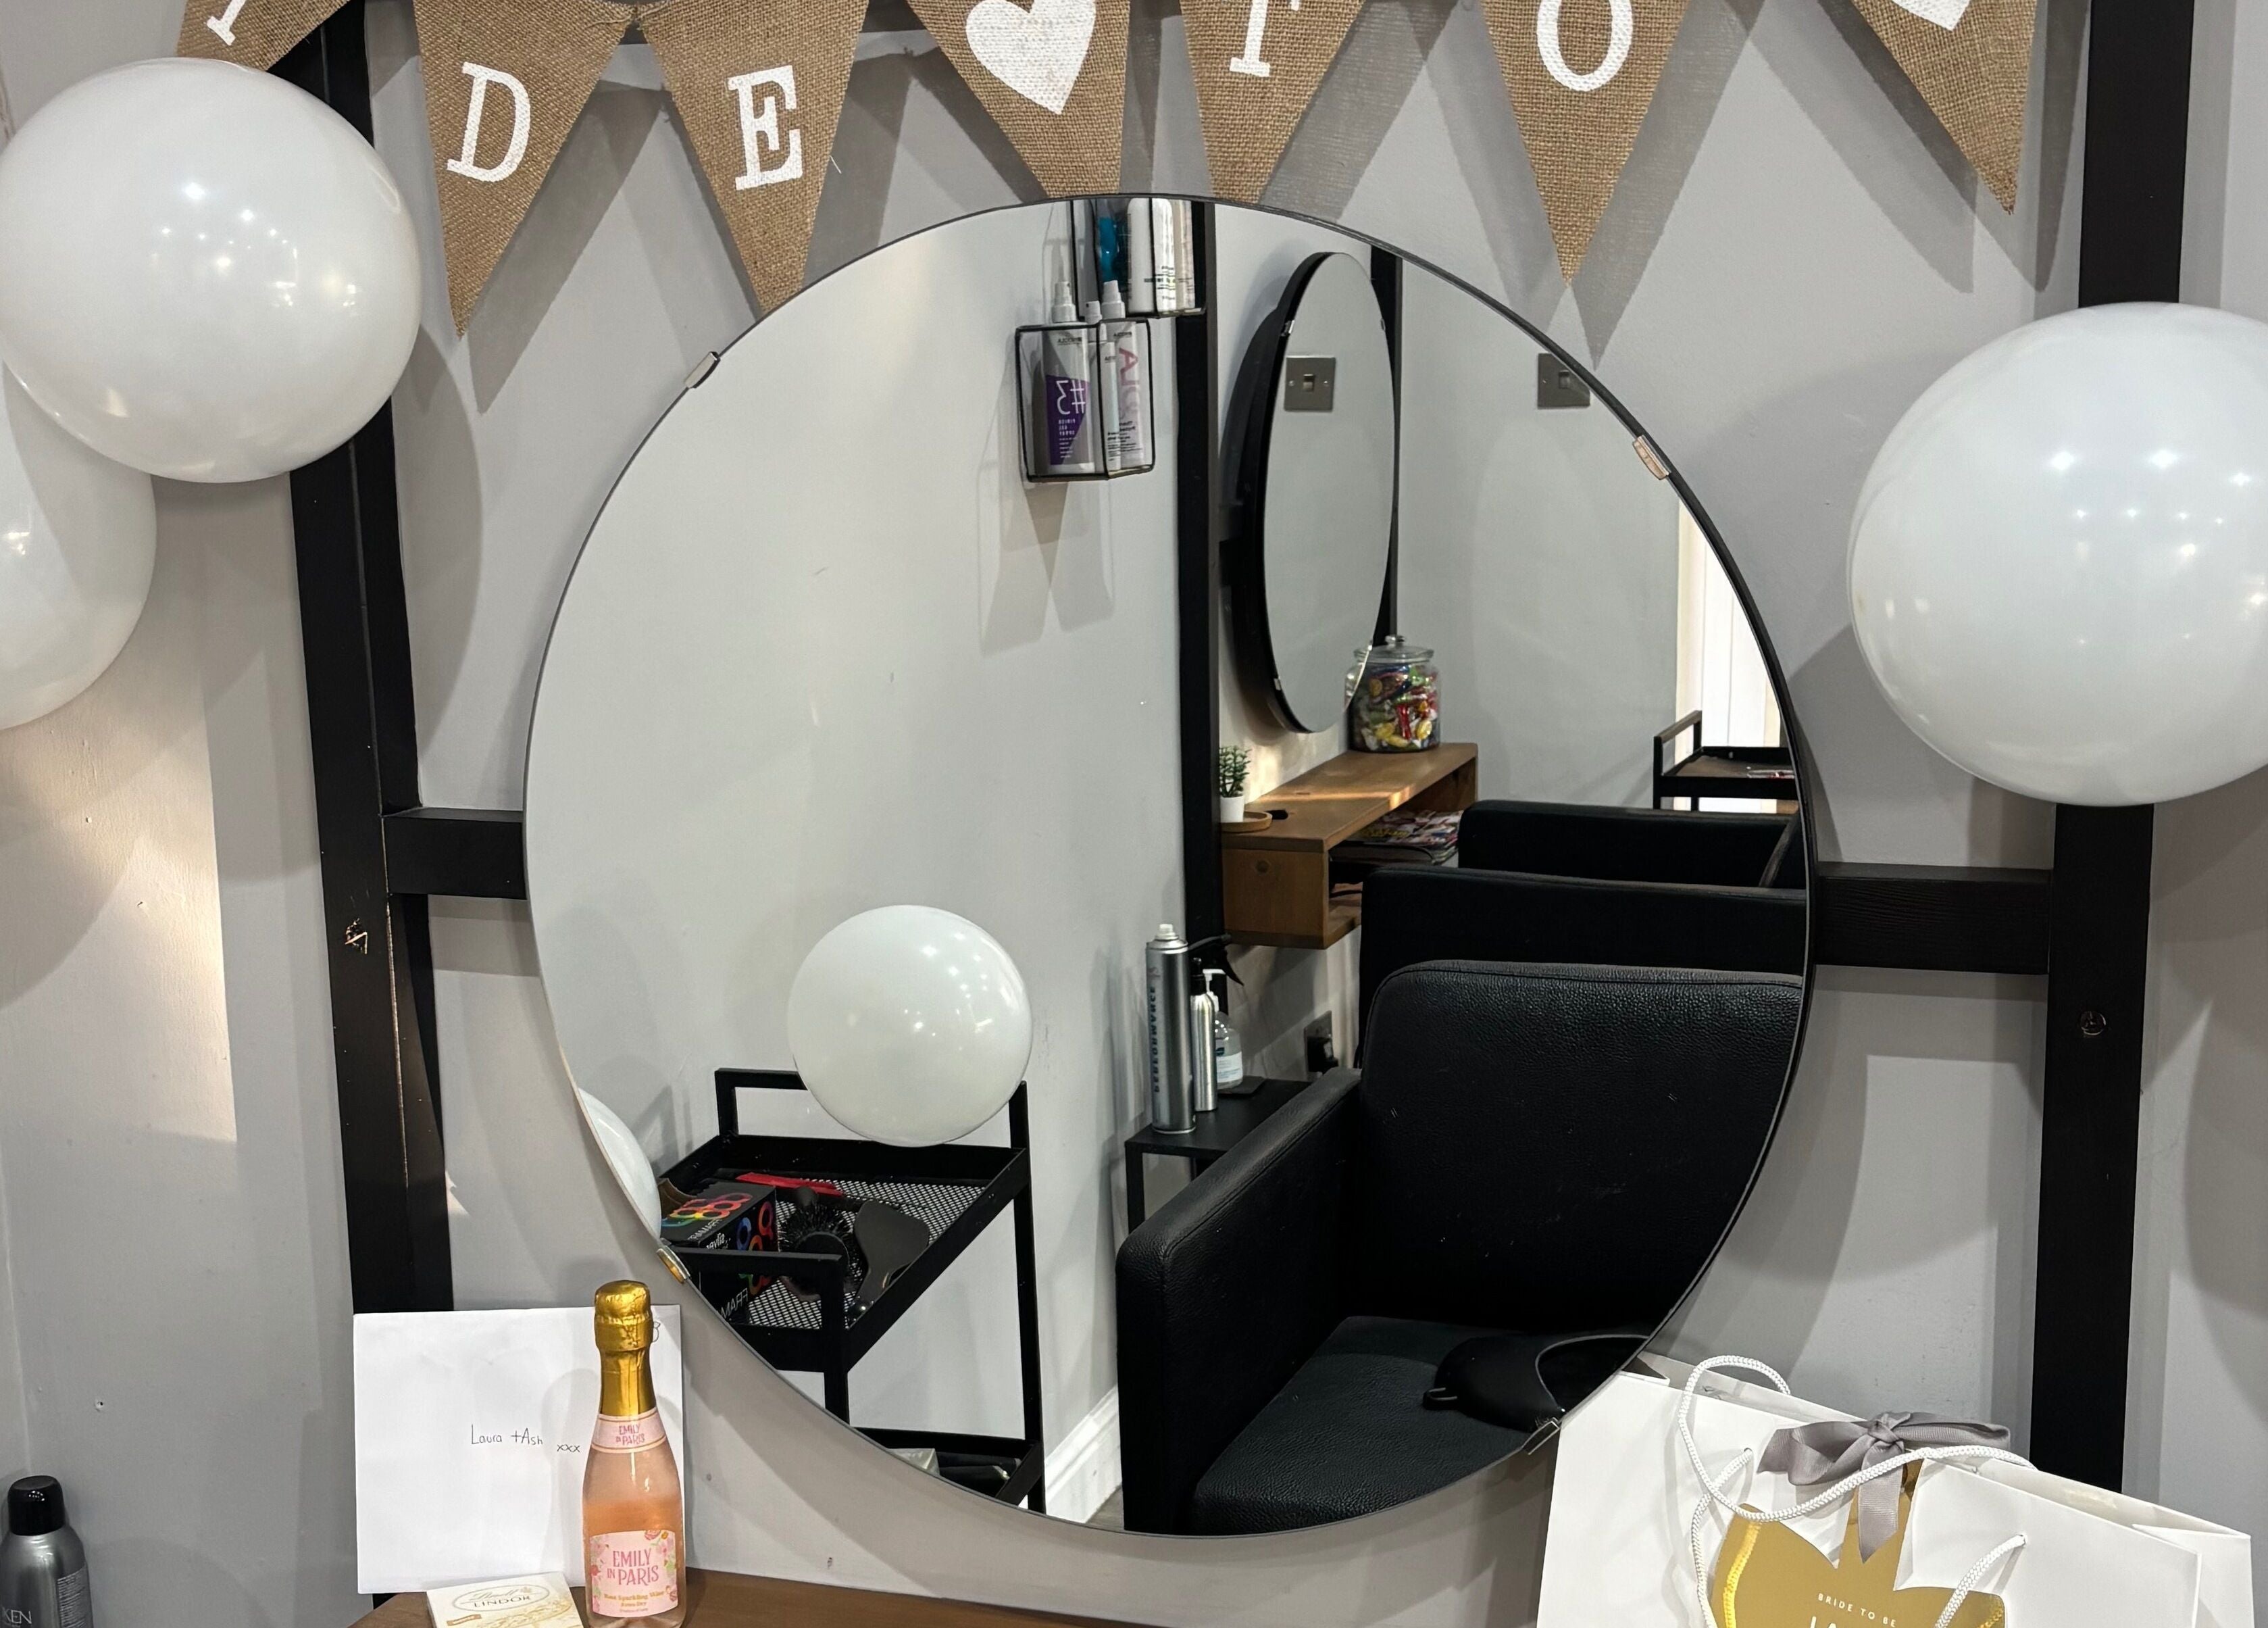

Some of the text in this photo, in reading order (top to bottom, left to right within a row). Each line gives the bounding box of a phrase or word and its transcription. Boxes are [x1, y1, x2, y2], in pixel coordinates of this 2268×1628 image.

[471, 1424, 503, 1445] Laura
[619, 1423, 640, 1435] EMILY
[622, 1433, 645, 1446] PARIS
[613, 1548, 652, 1568] EMILY
[607, 1565, 659, 1586] IN PARIS
[474, 1595, 531, 1608] LINDOR
[1818, 1593, 1897, 1628] BRIDE TO BE
